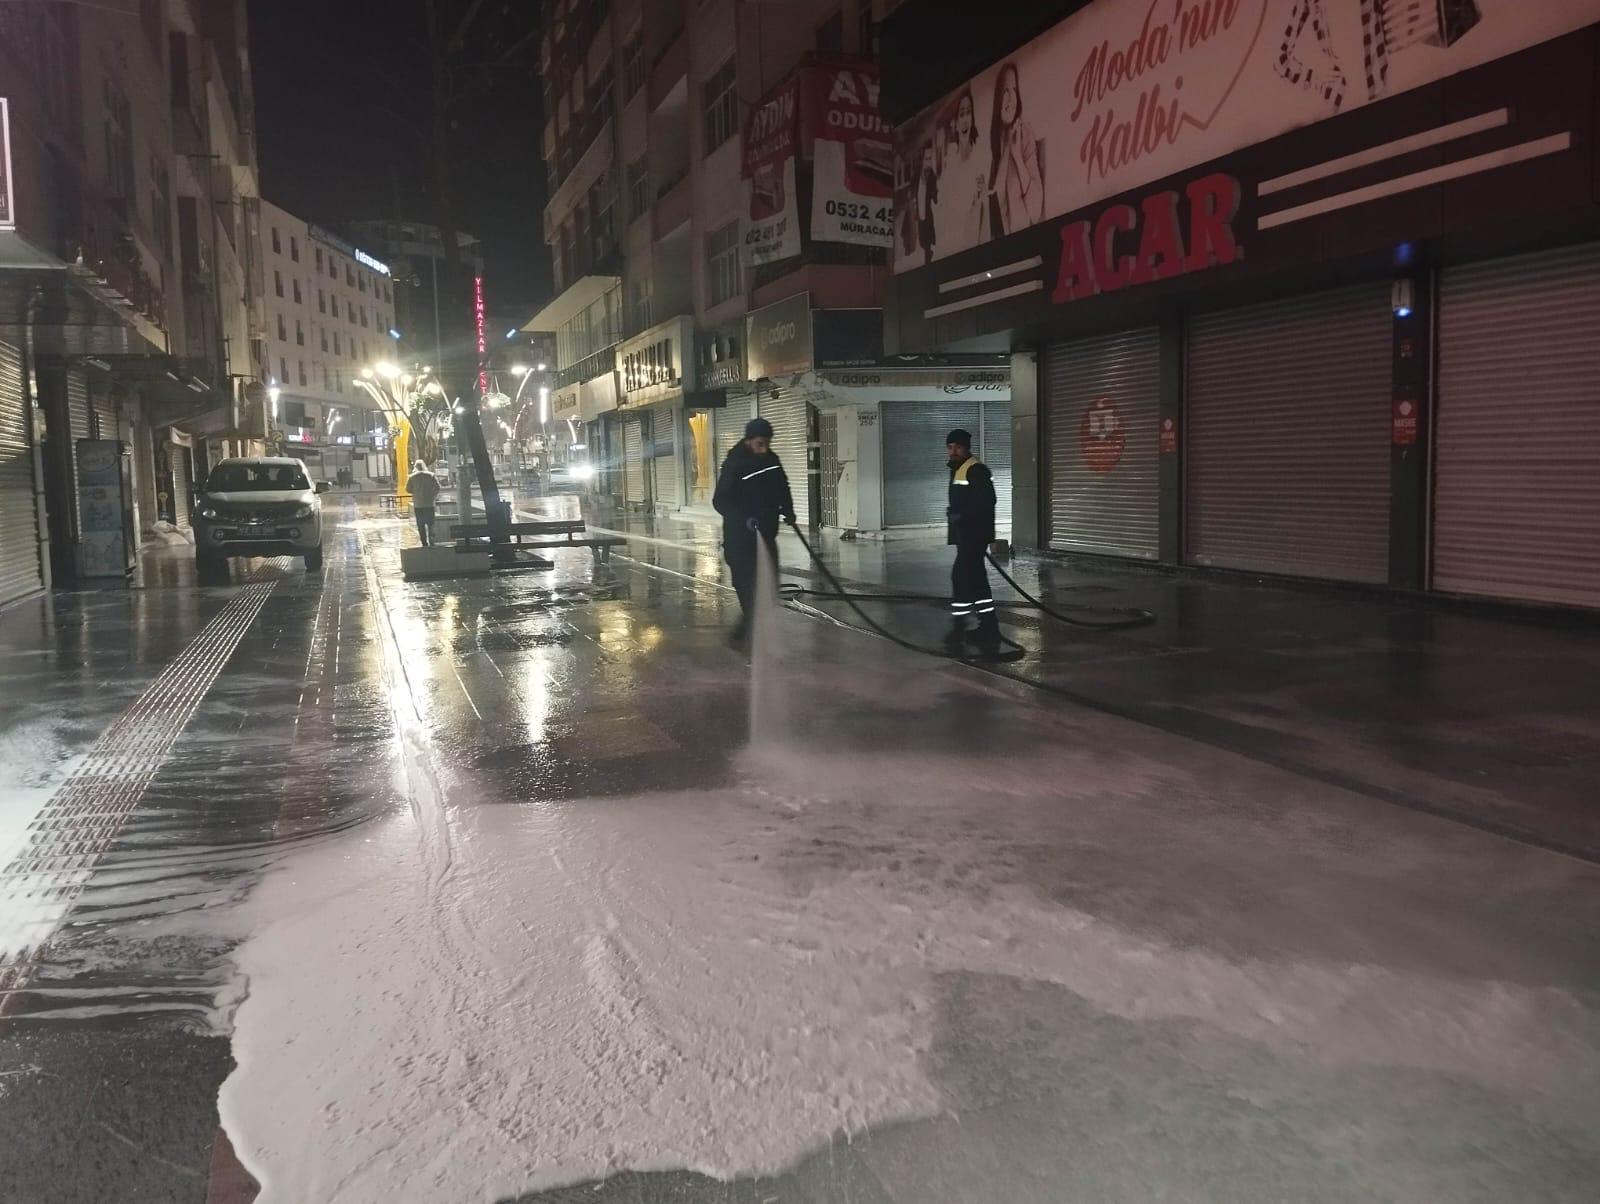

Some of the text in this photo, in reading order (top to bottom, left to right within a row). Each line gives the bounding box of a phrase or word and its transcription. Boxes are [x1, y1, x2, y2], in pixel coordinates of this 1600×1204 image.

[1081, 76, 1184, 185] Kalbi
[826, 199, 870, 220] 0532
[1052, 172, 1244, 304] ACAR
[769, 320, 796, 347] adipro
[842, 373, 881, 386] adipro
[968, 371, 1005, 384] adipro
